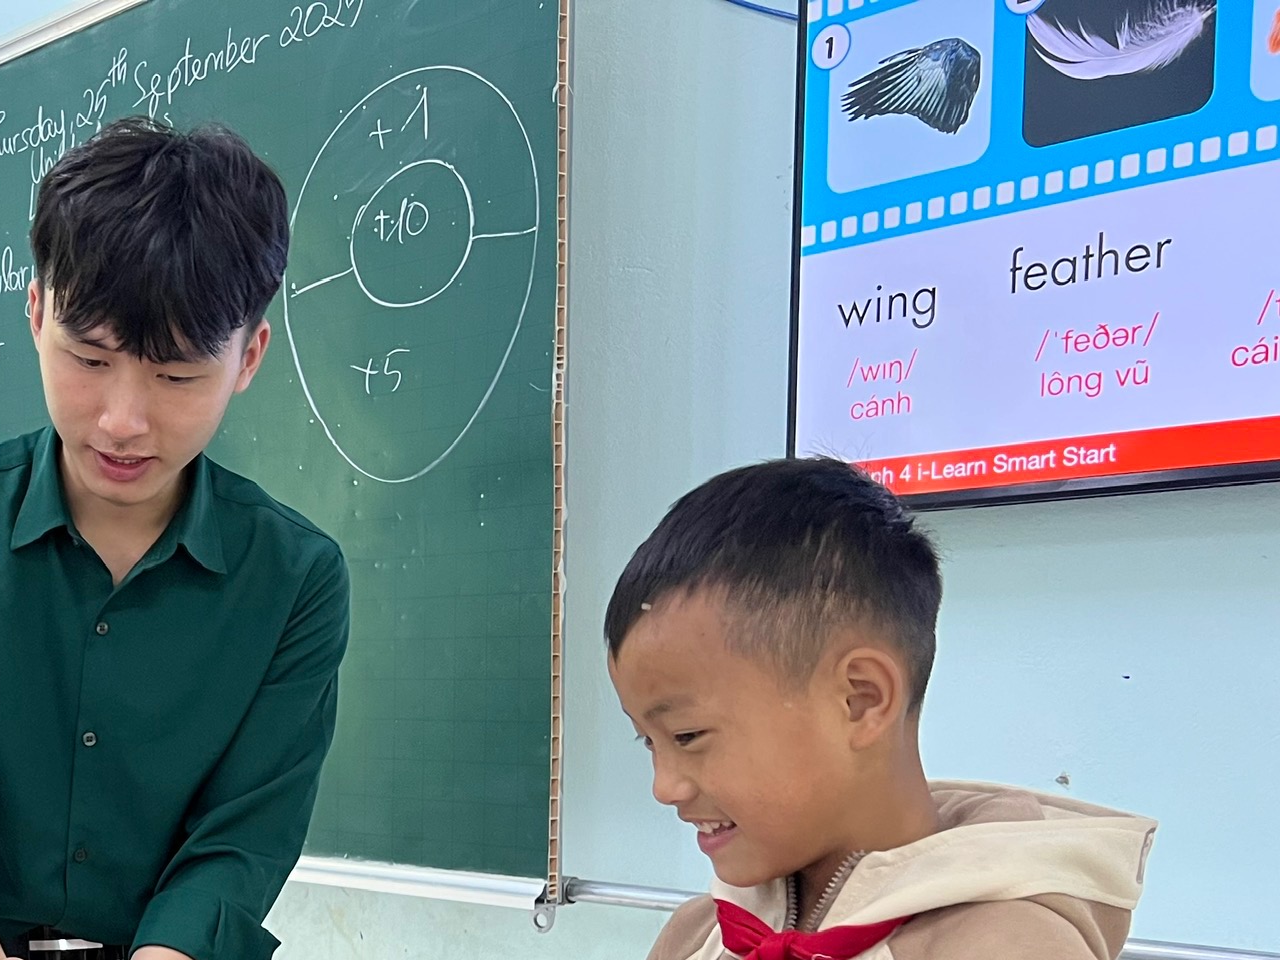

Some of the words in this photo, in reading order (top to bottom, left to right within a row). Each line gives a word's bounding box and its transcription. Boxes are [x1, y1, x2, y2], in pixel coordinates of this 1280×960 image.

[132, 26, 270, 108] September
[825, 36, 834, 59] 1
[1010, 231, 1172, 294] feather
[837, 285, 937, 329] wing
[350, 349, 410, 395] +5
[1231, 336, 1280, 367] cái
[1040, 371, 1102, 398] lông
[1115, 359, 1149, 387] vũ
[850, 391, 912, 420] cánh
[869, 466, 894, 486] nh
[899, 464, 912, 482] 4
[917, 459, 987, 481] i-Learn
[993, 450, 1057, 474] Smart
[1063, 443, 1117, 468] Start
